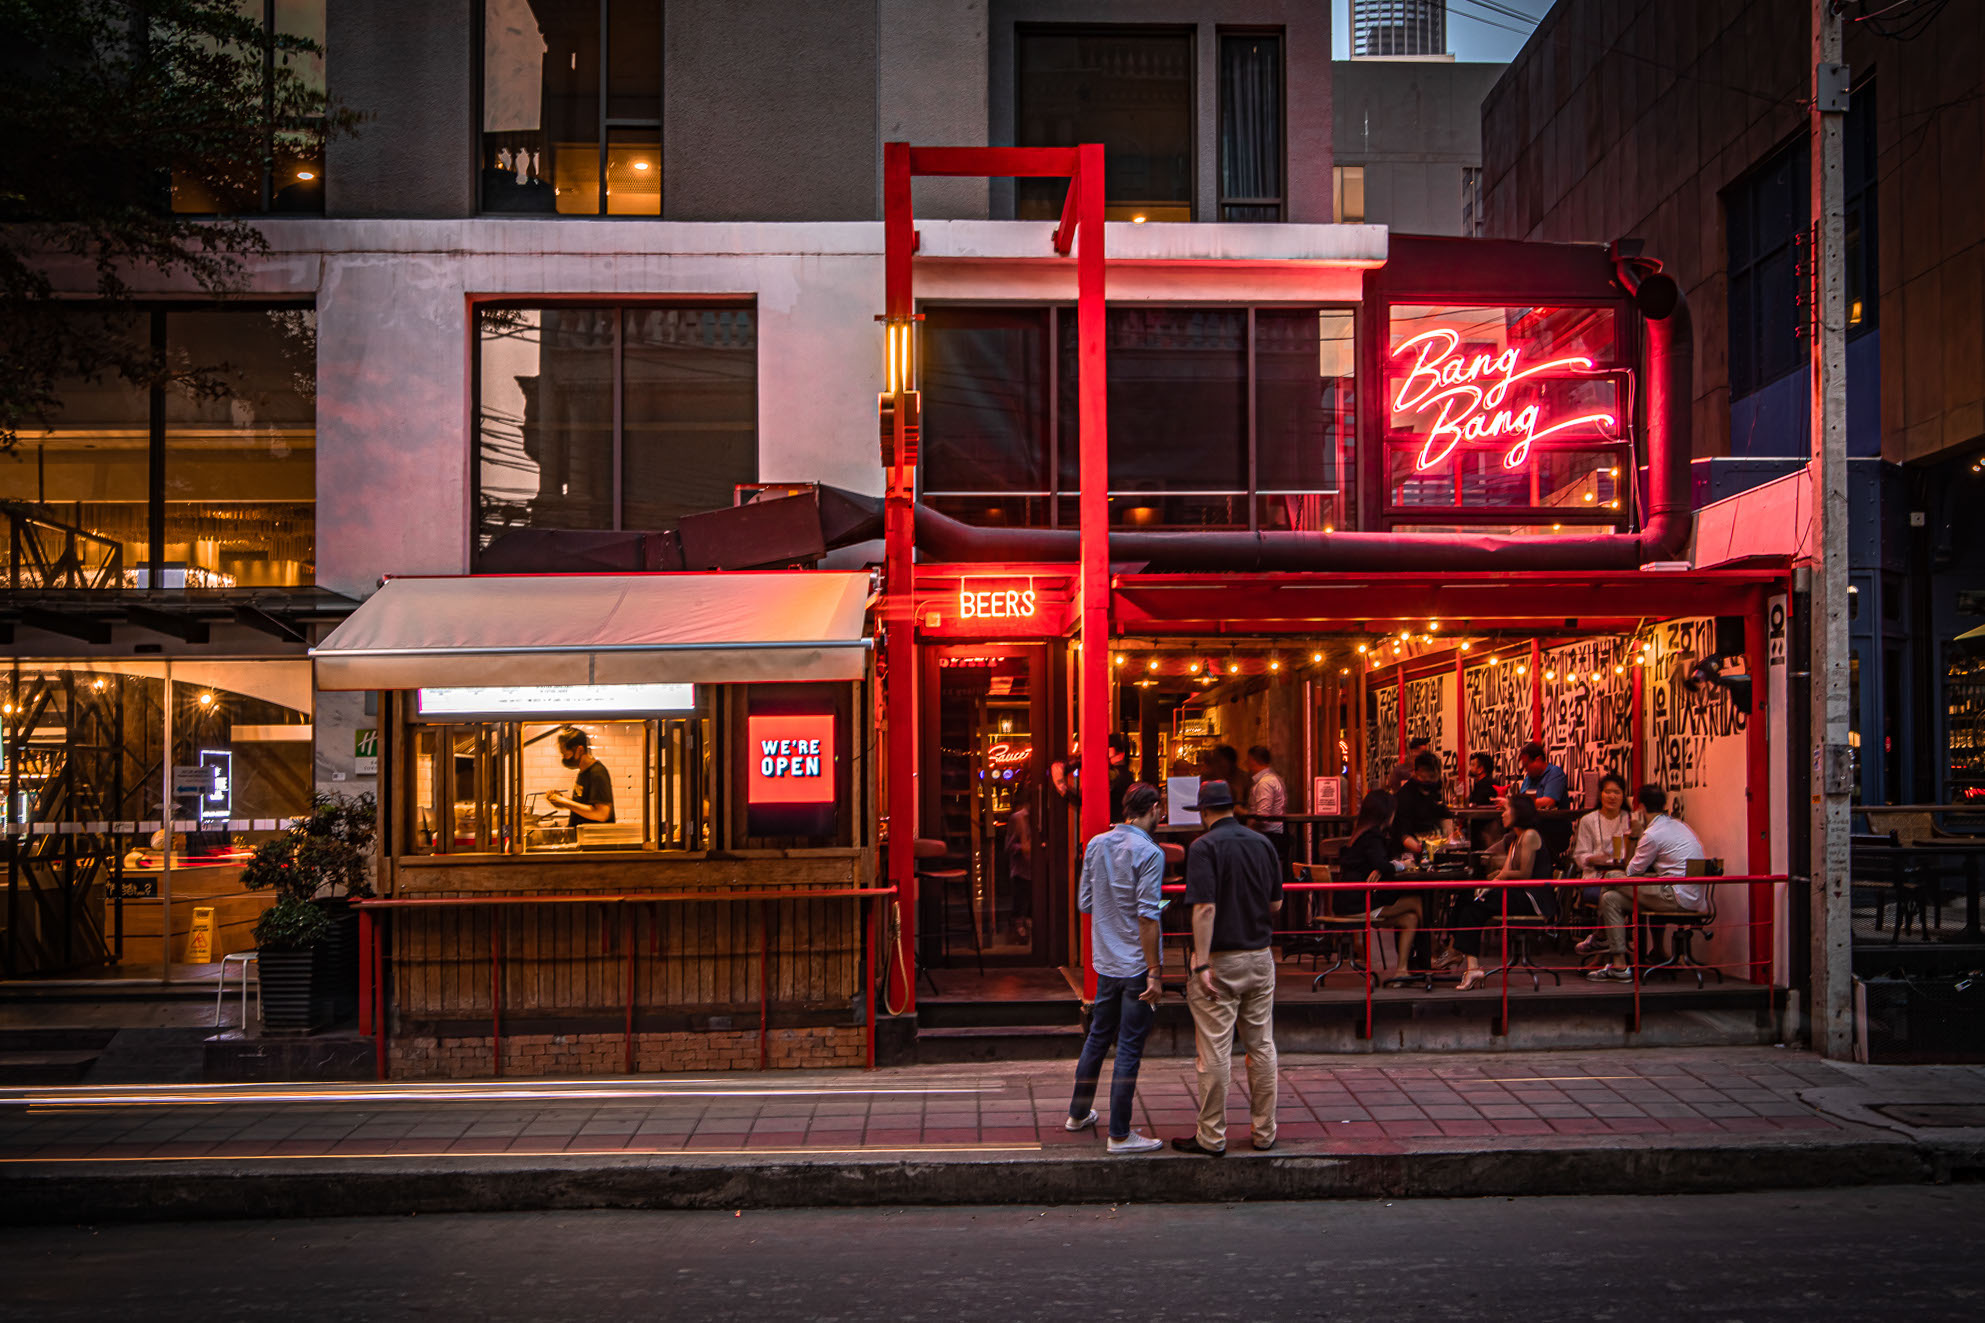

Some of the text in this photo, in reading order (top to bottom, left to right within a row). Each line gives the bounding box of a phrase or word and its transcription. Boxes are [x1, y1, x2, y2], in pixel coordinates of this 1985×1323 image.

[1391, 328, 1594, 413] Bang
[1415, 385, 1615, 471] Bang
[959, 590, 1036, 619] BEERS
[760, 739, 821, 756] WE'RE
[760, 756, 821, 778] OPEN
